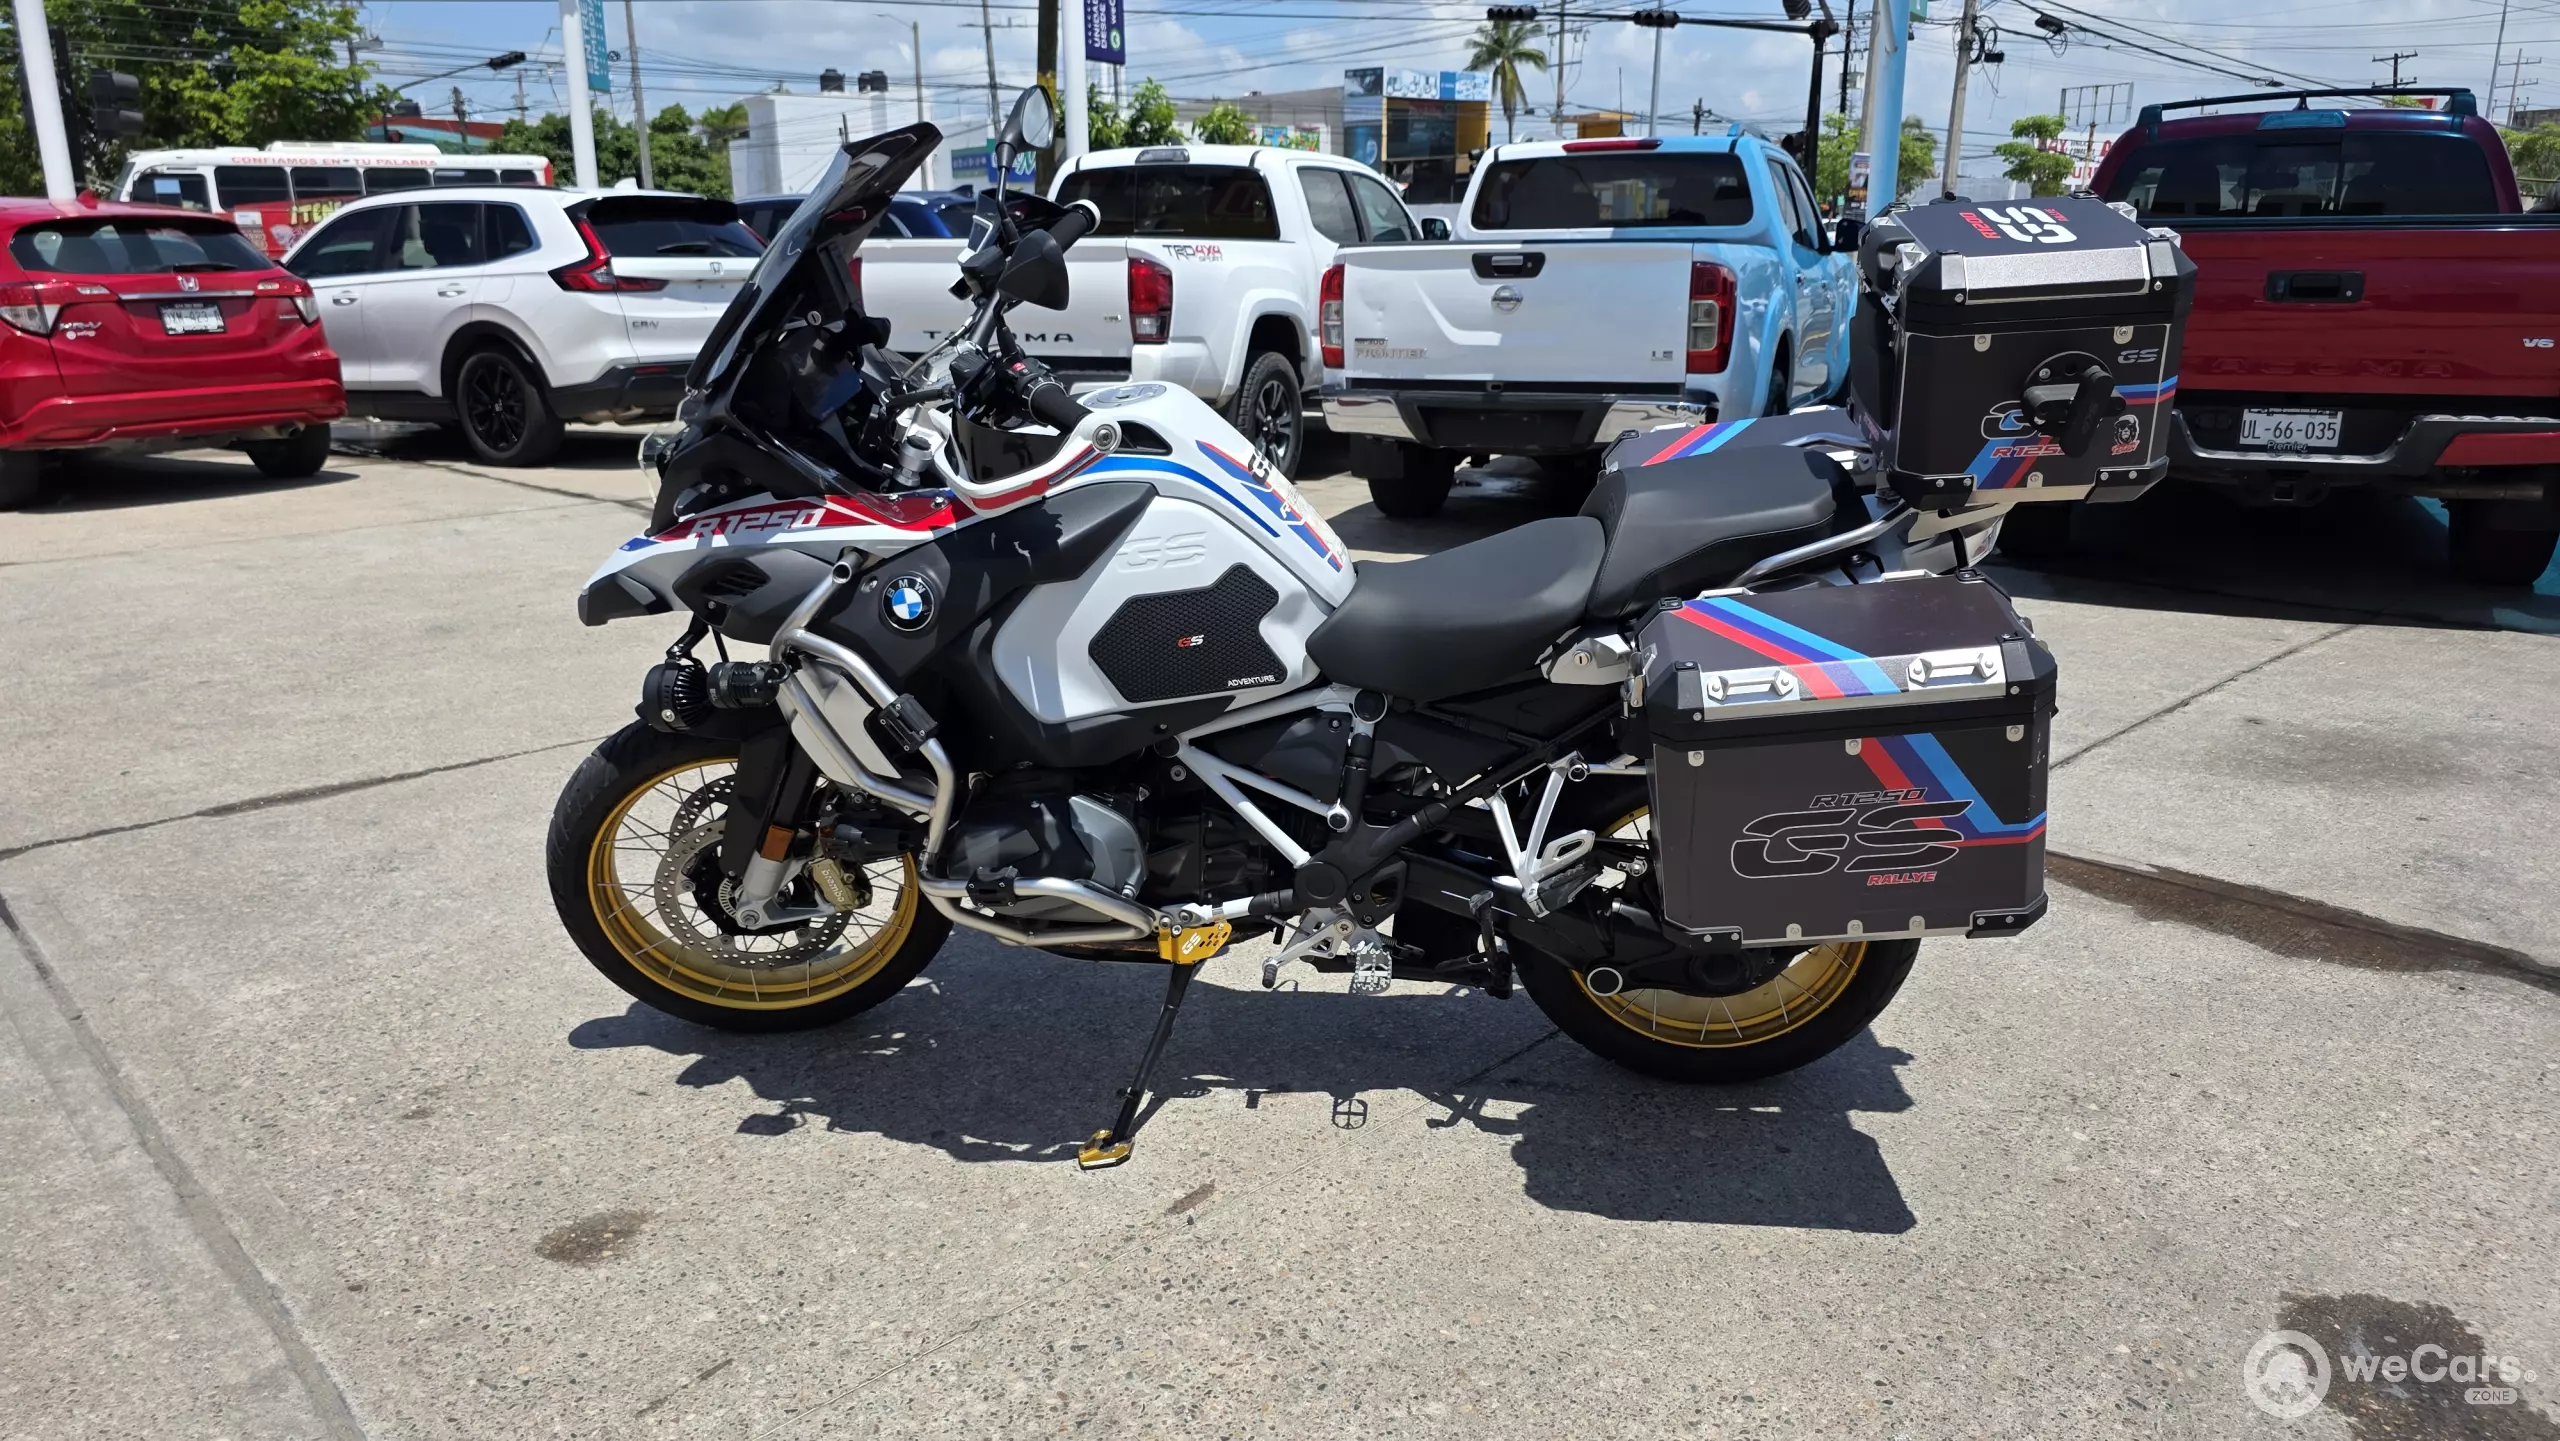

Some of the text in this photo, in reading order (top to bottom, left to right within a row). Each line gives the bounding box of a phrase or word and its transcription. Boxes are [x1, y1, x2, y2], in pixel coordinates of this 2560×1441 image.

[1099, 3, 1108, 49] DESDE
[231, 156, 318, 166] CONFIAMOS
[322, 158, 341, 166] EN
[355, 158, 371, 166] TU
[376, 158, 438, 167] PALABRA
[1977, 206, 2078, 245] GS
[2522, 336, 2555, 349] V6
[1355, 347, 1429, 360] FRONTIER
[1650, 350, 1674, 362] LE
[2117, 347, 2160, 364] GS
[2241, 418, 2338, 442] UL-66-035
[1990, 443, 2067, 459] R125
[2266, 439, 2310, 454] Premier
[1117, 530, 1208, 574] GS
[885, 578, 927, 599] BMW
[1176, 633, 1206, 649] GS
[1226, 673, 1277, 689] ADVENTURE
[1730, 799, 1975, 880] GS
[820, 868, 846, 903] brembo
[1865, 870, 1938, 887] RALLYE
[1180, 931, 1203, 956] GS
